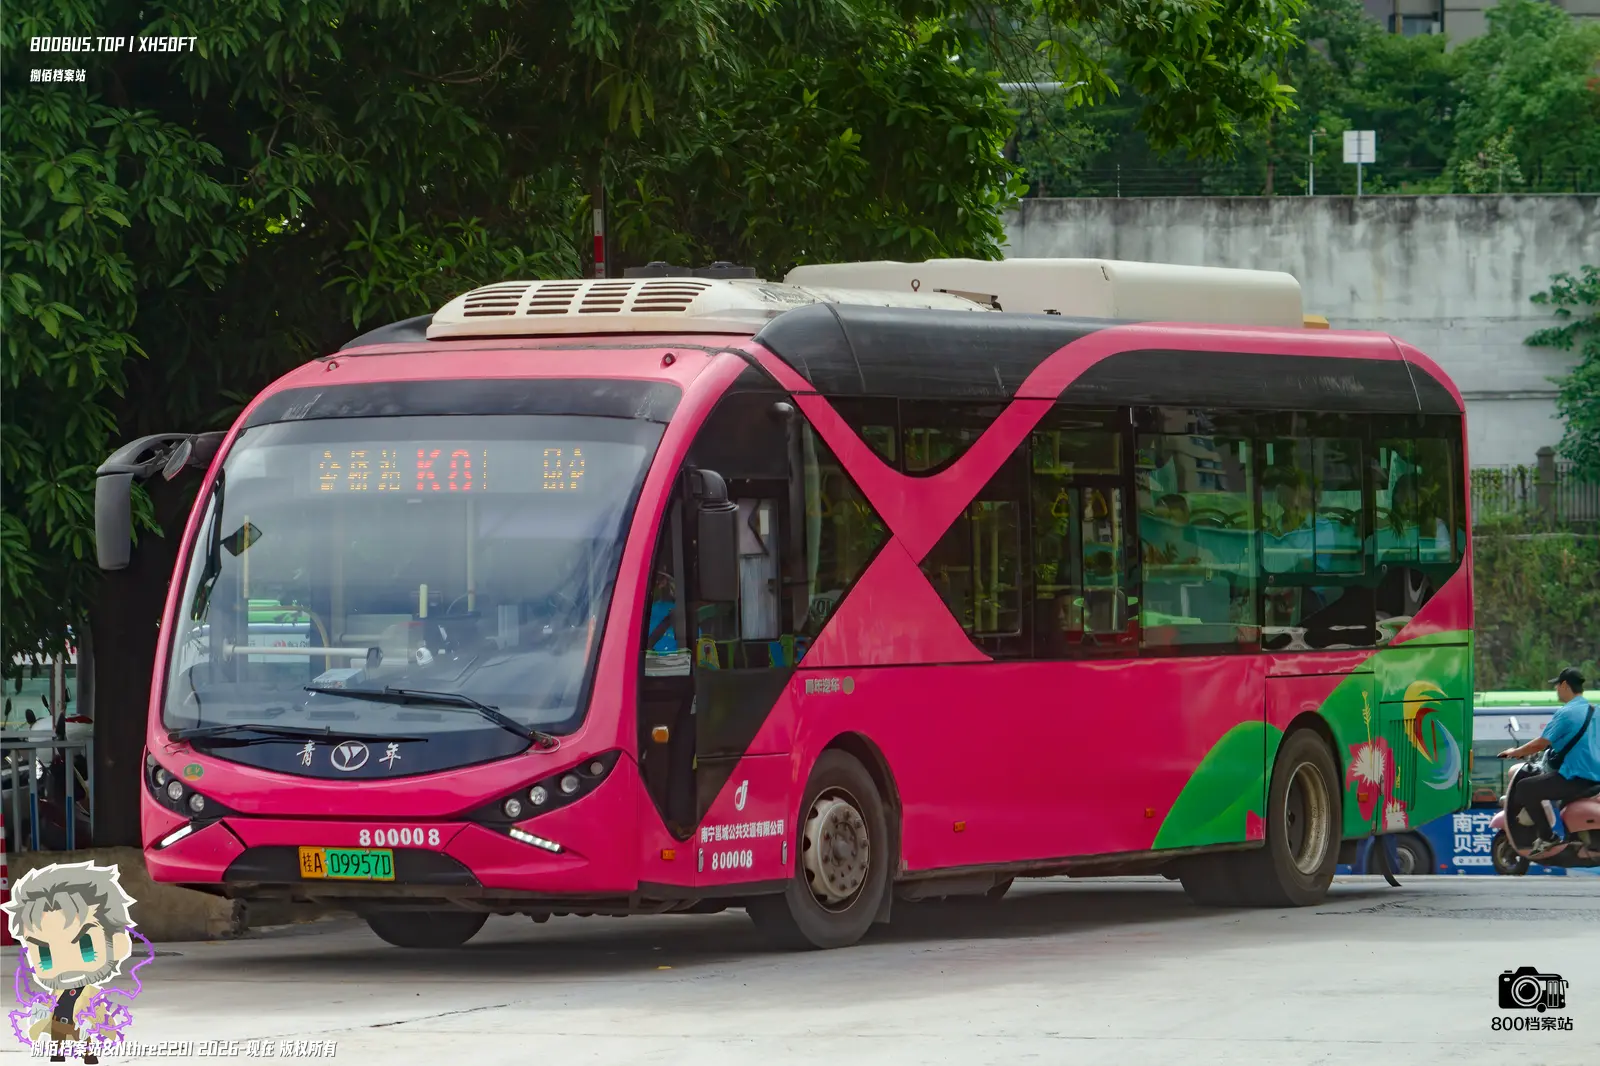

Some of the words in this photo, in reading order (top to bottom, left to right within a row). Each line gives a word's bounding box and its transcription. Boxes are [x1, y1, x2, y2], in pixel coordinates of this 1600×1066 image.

[1452, 812, 1500, 833] 南宁
[359, 827, 440, 846] 800008
[1453, 833, 1496, 853] 贝壳
[711, 849, 753, 870] 800008
